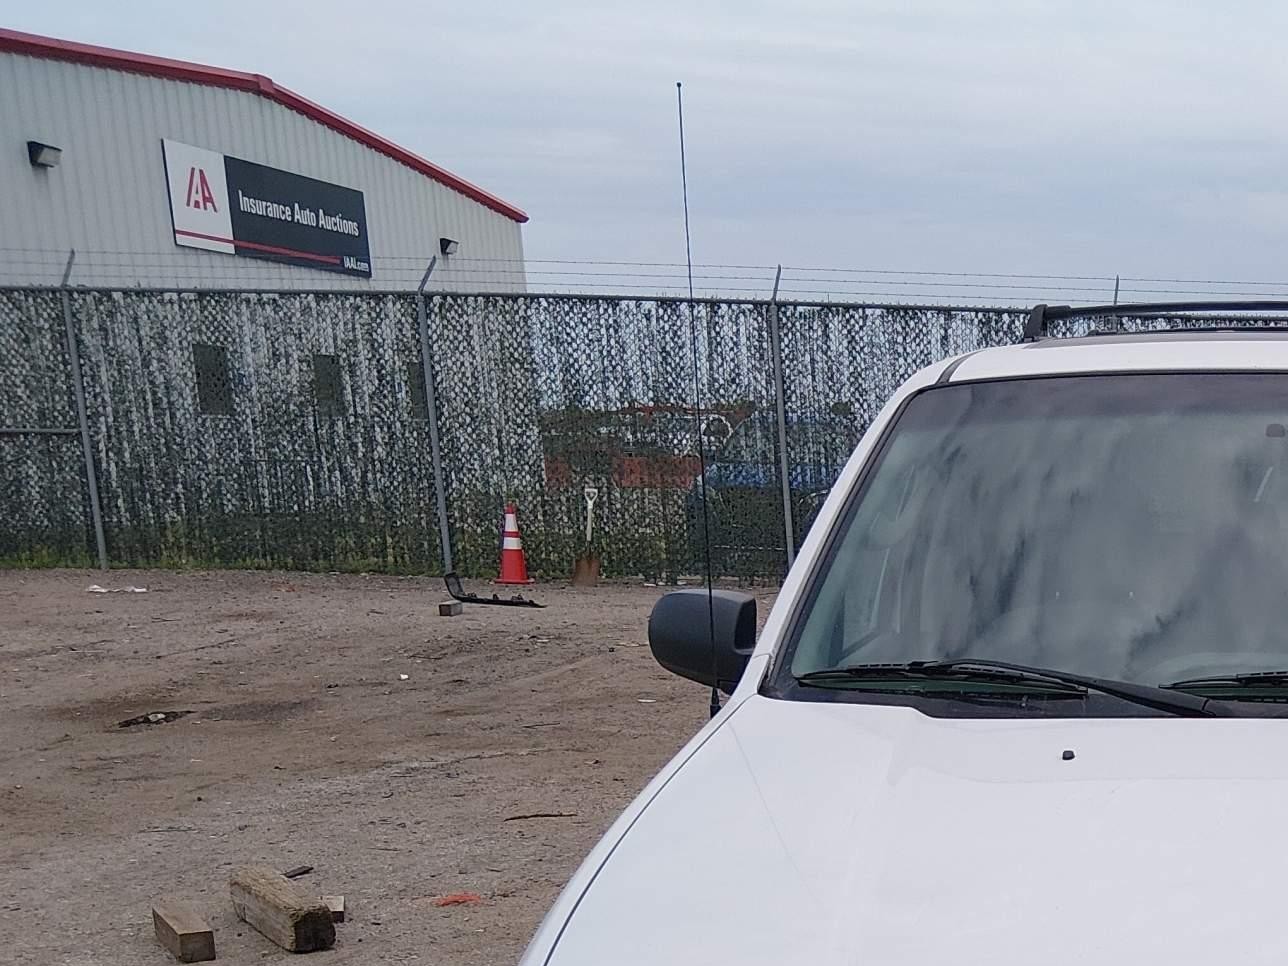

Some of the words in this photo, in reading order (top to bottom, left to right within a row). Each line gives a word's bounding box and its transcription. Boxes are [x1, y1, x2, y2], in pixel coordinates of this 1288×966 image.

[238, 190, 292, 222] Insurance
[294, 203, 317, 228] Auto
[318, 209, 359, 237] Auctions
